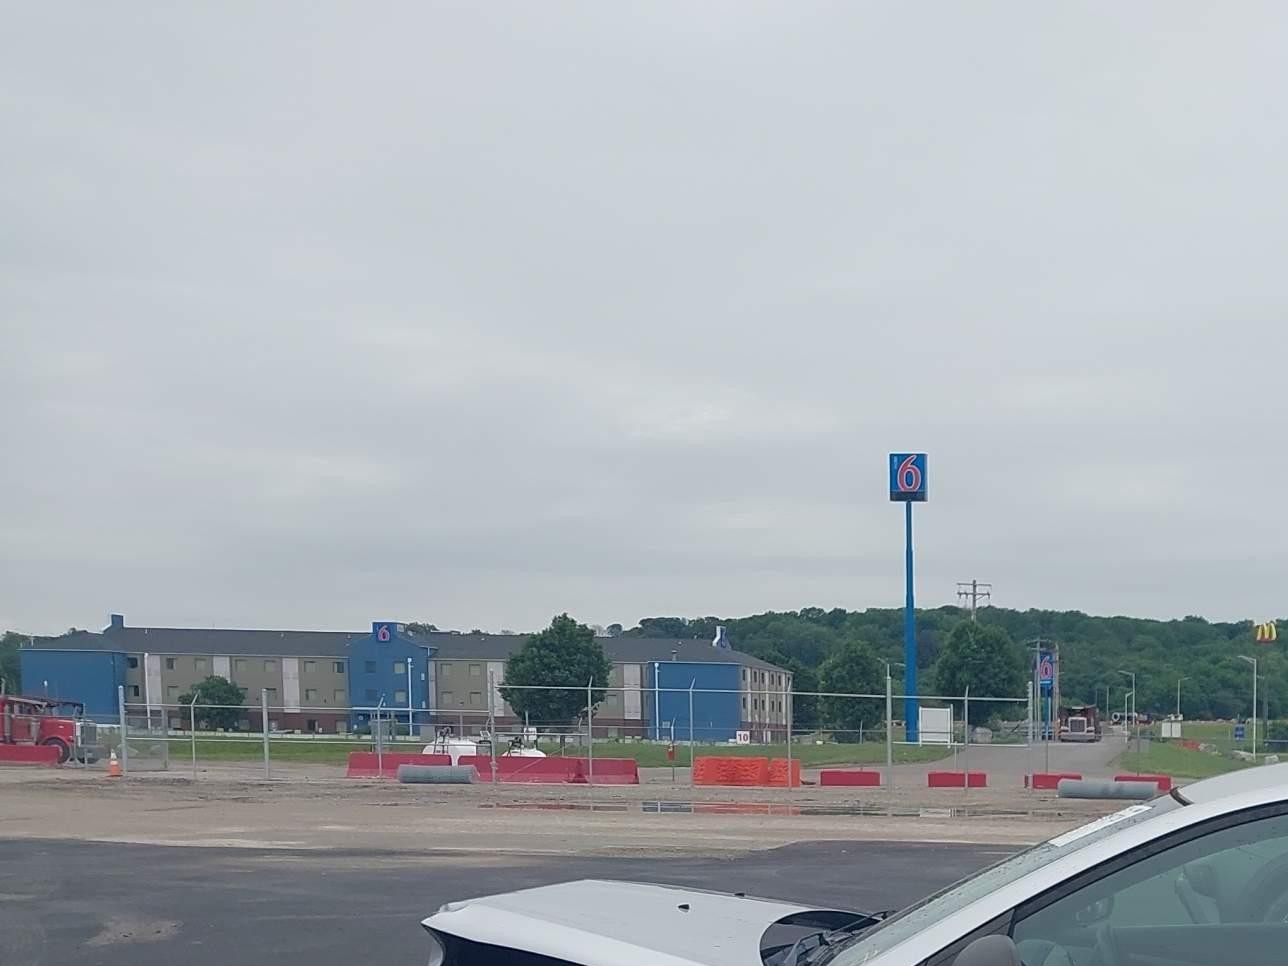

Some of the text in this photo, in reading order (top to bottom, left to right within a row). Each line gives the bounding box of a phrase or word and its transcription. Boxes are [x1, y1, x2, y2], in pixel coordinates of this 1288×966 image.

[897, 454, 922, 492] 6
[378, 624, 390, 641] 6
[1040, 655, 1053, 680] 6
[737, 733, 749, 742] 10
